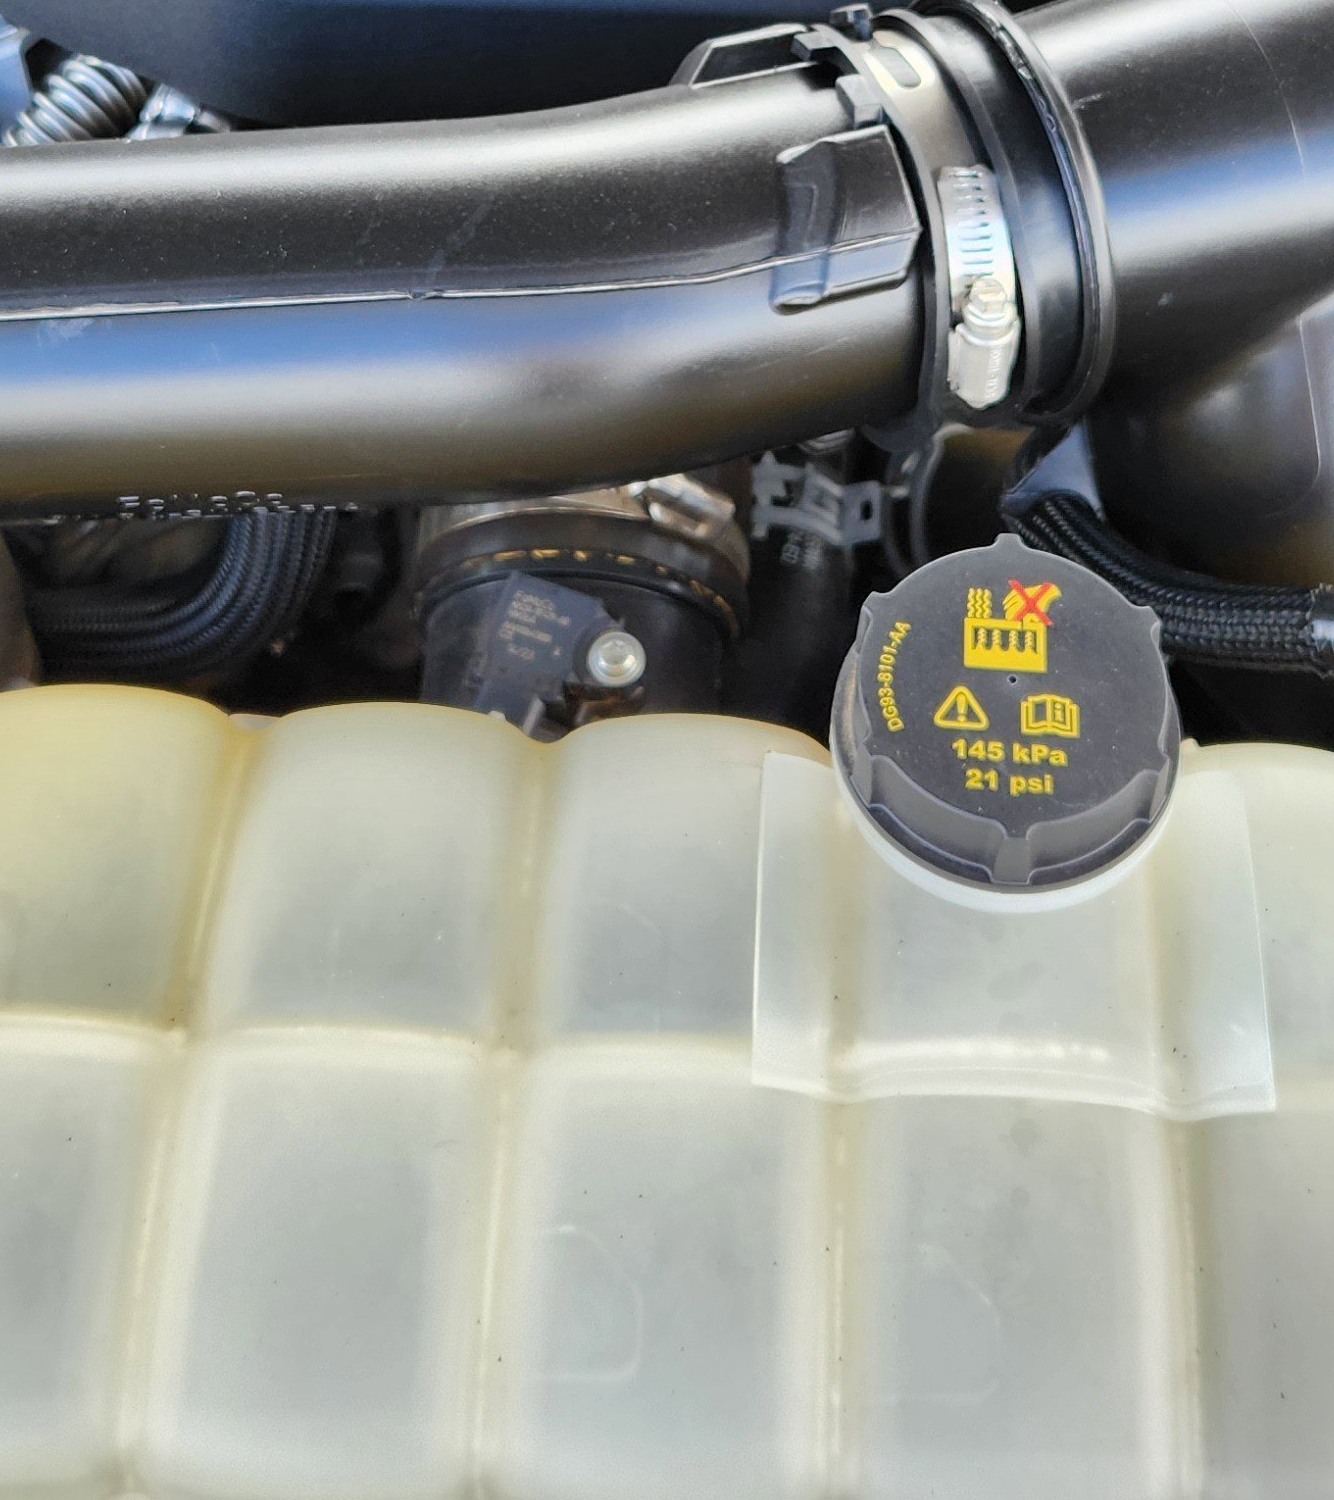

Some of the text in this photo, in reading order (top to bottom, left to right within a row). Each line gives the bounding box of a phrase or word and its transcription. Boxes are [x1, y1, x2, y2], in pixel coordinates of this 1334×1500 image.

[877, 620, 912, 732] DG93-8101-AA
[952, 738, 1068, 767] 145 kPa
[965, 768, 1055, 797] 21 psi
